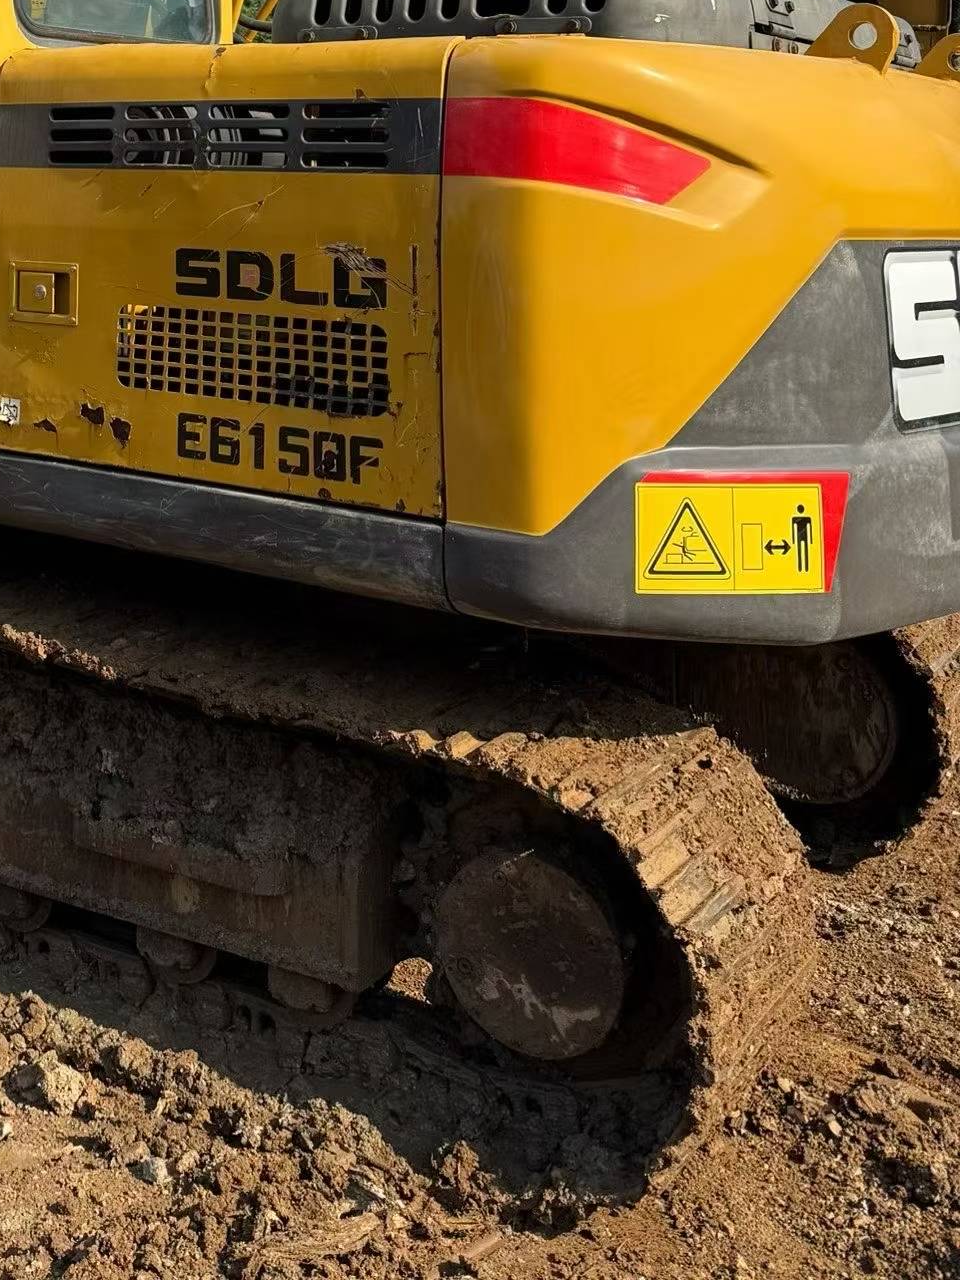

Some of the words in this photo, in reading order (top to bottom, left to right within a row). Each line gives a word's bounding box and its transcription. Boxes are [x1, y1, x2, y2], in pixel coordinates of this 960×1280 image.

[176, 247, 388, 310] SDLG
[882, 249, 960, 426] S
[177, 412, 384, 485] E6150F
